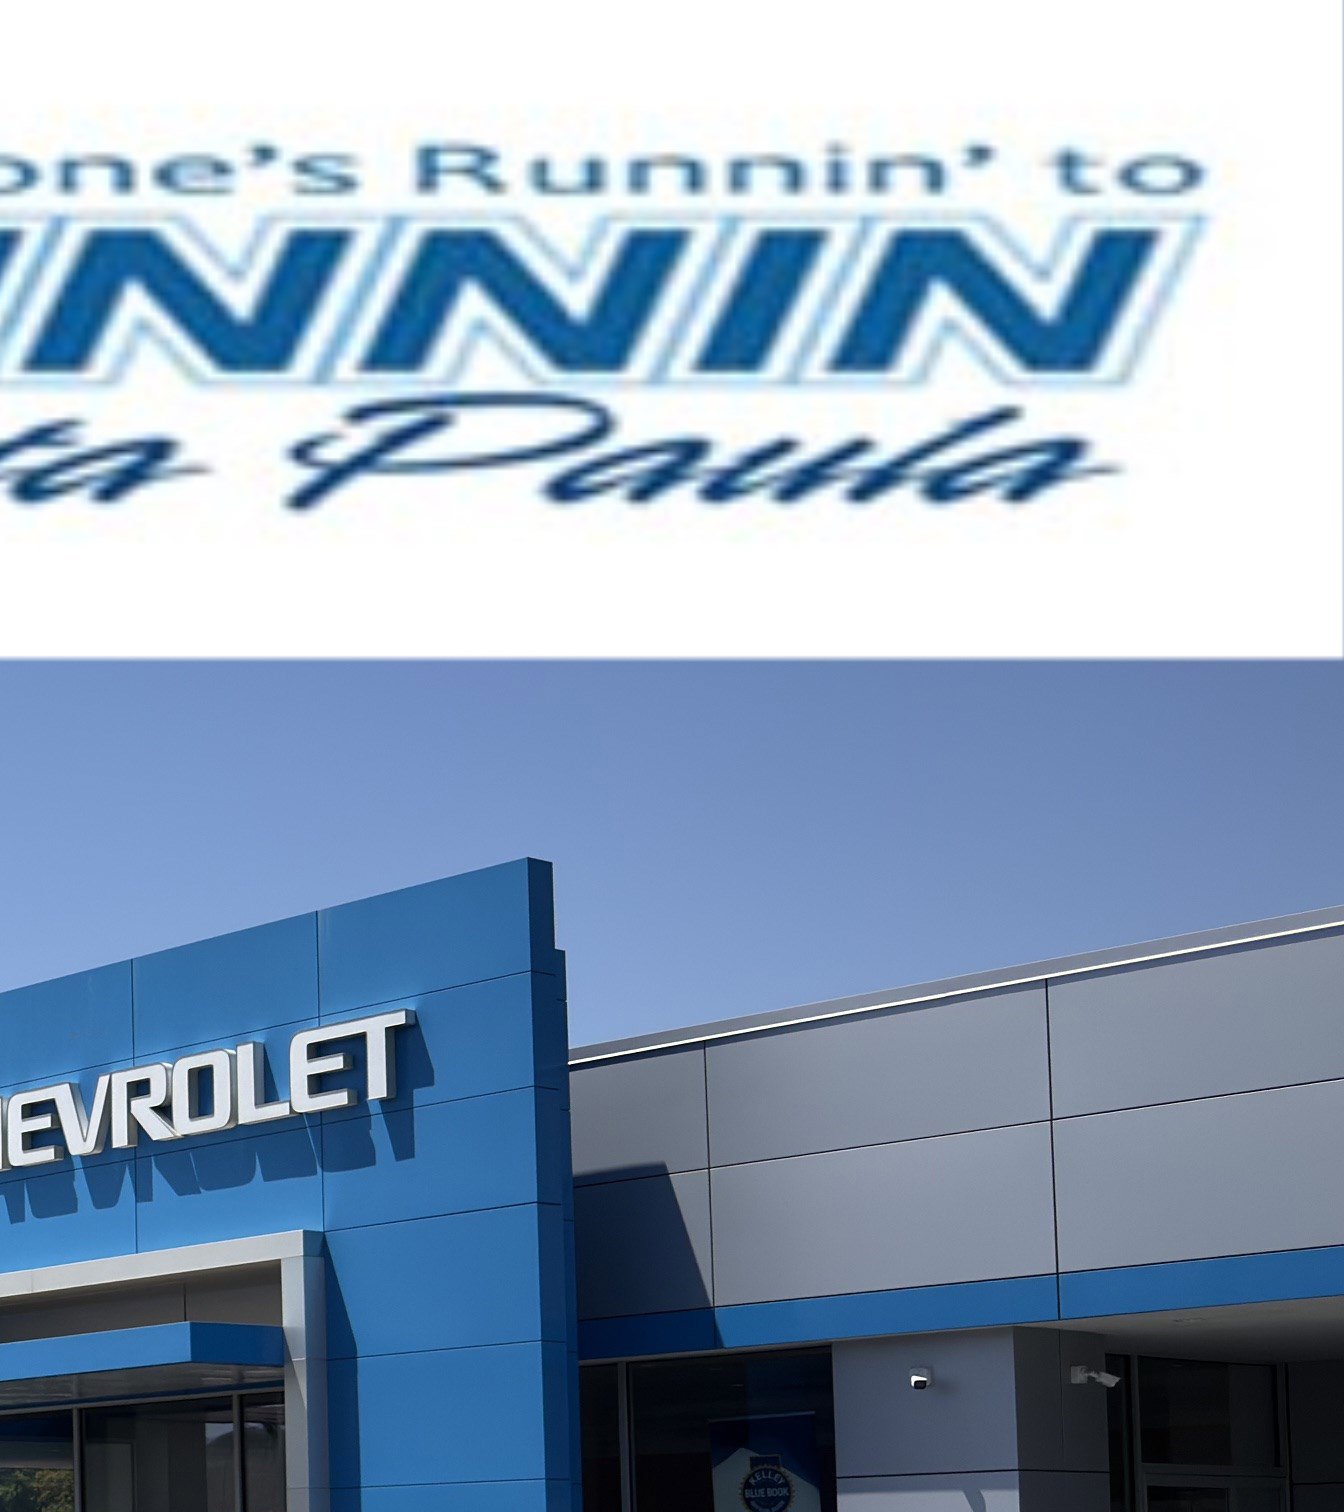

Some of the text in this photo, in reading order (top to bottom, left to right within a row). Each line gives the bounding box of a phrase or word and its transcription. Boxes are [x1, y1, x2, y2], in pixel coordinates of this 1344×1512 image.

[748, 1469, 787, 1486] KELLEY
[745, 1487, 790, 1498] BLUE BOOK
